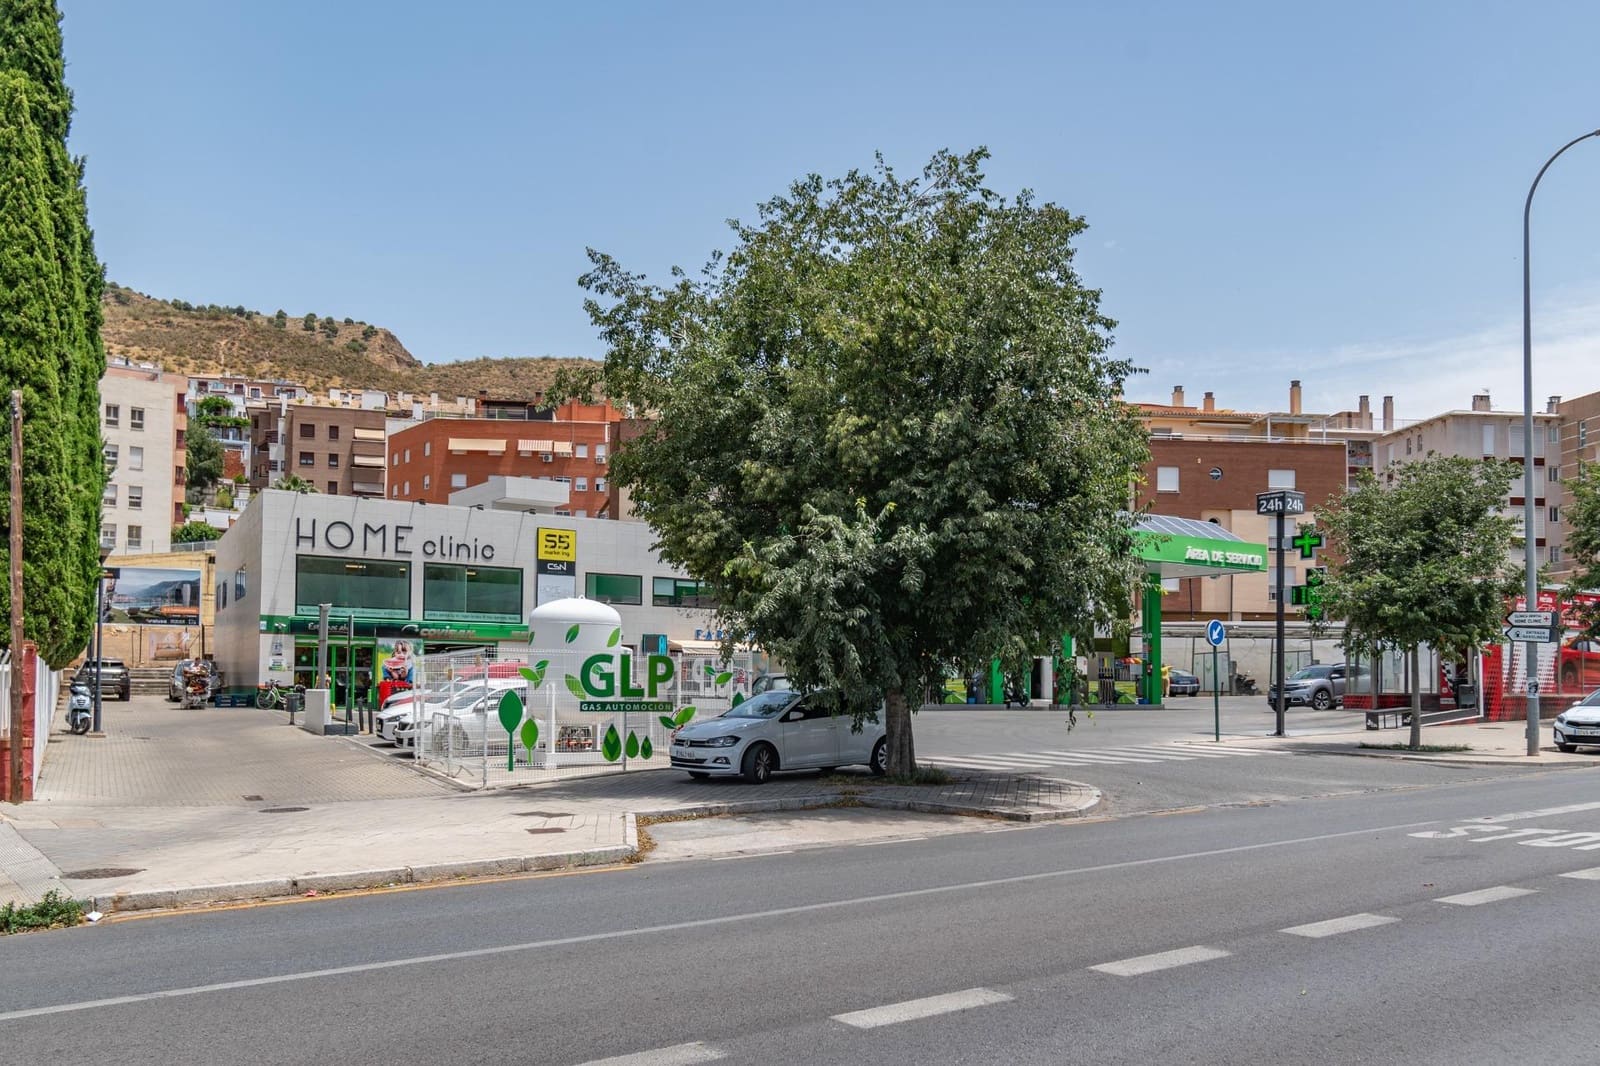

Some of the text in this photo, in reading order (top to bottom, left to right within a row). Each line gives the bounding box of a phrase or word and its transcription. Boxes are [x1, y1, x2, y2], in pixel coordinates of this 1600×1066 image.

[1259, 497, 1283, 512] 24h
[1287, 498, 1303, 512] 24h
[296, 517, 495, 560] HOME clinic
[1211, 550, 1225, 563] DE
[1225, 552, 1263, 566] SERVICIO
[547, 561, 567, 571] CSN
[580, 653, 675, 698] GLP
[581, 703, 602, 711] GAS
